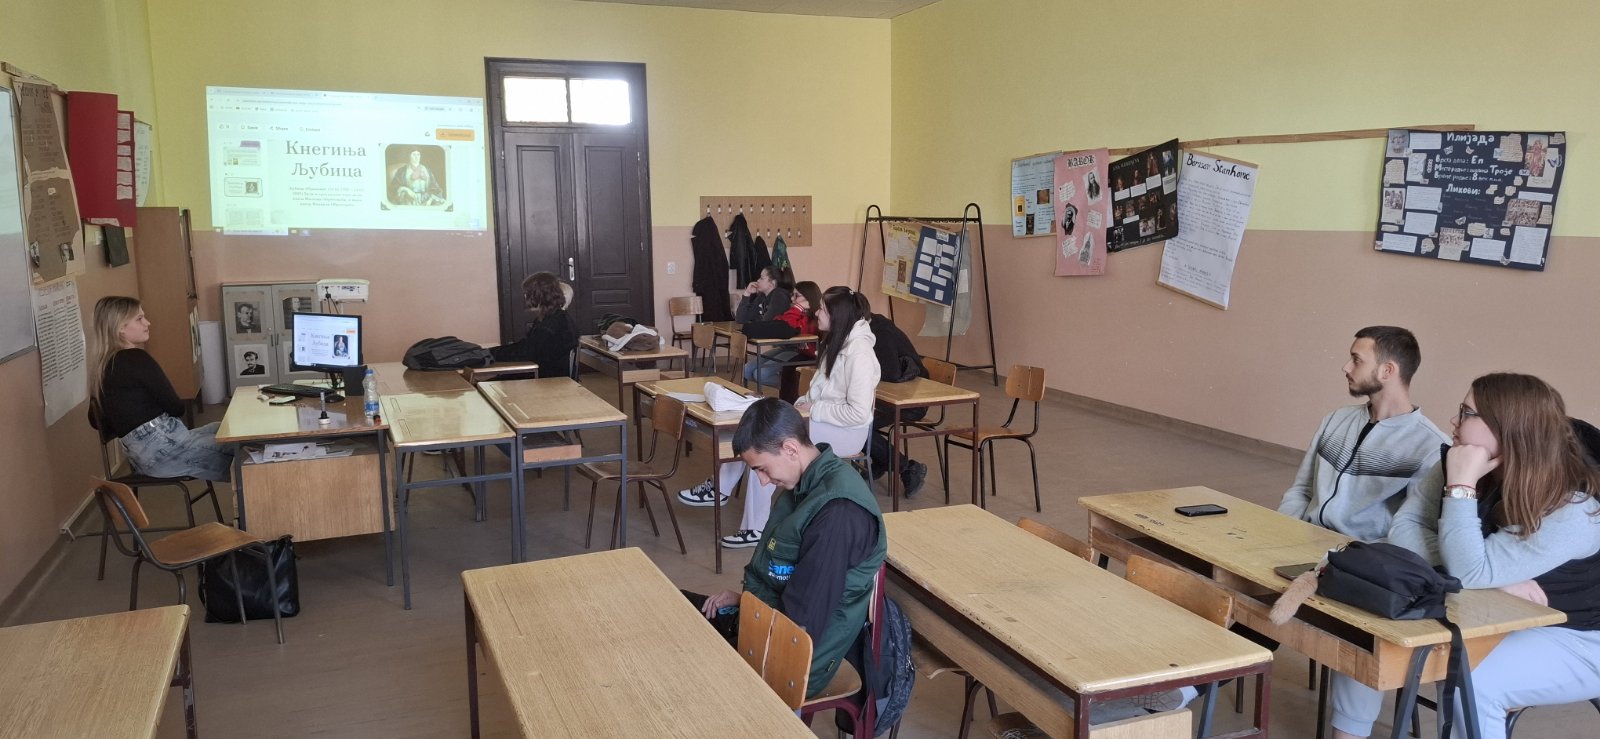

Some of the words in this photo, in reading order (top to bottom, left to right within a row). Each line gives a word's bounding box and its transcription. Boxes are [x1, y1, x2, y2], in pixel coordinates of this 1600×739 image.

[1446, 132, 1495, 146] Илијада
[286, 140, 367, 156] Кнегиња
[1471, 155, 1484, 164] Еп
[291, 162, 363, 179] Љубица
[1489, 164, 1513, 176] Троје
[1446, 183, 1481, 195] Ликови:
